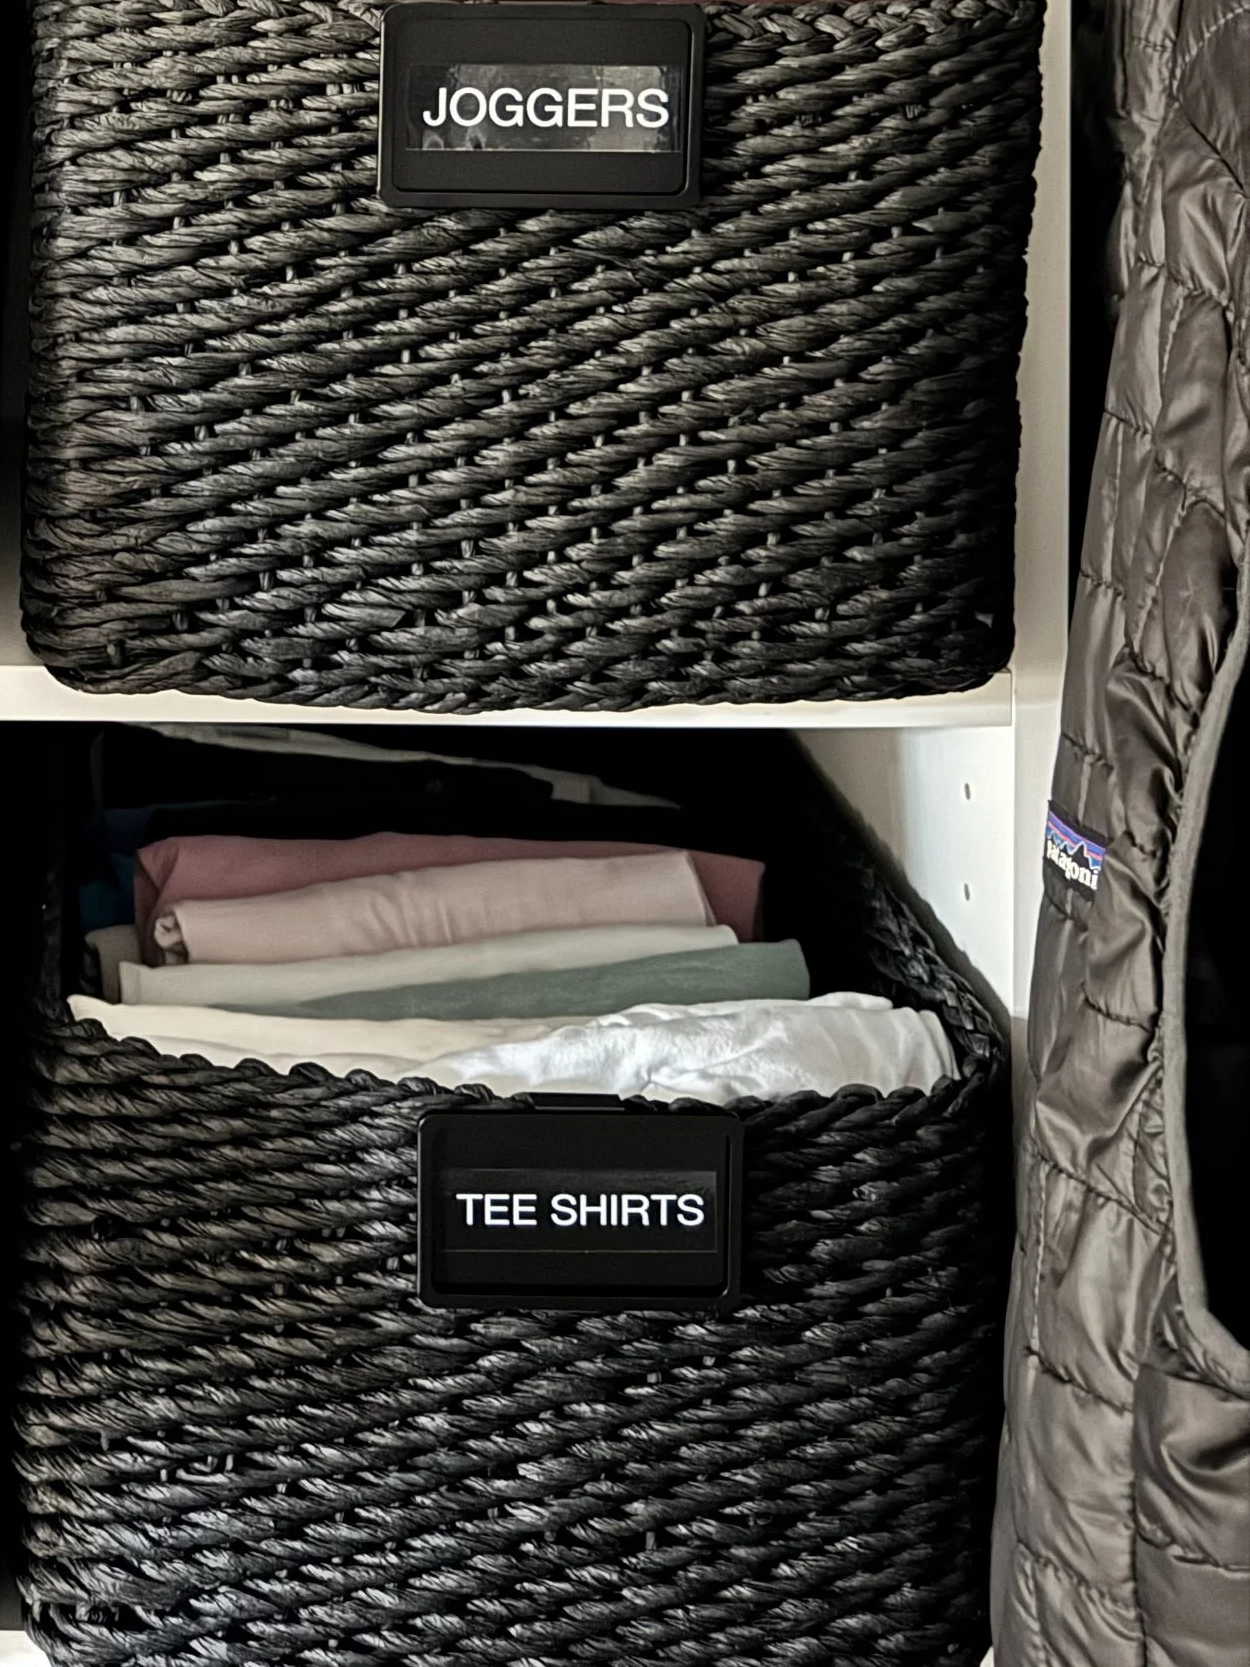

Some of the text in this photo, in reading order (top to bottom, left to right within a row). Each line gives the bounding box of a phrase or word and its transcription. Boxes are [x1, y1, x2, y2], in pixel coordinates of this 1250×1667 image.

[422, 86, 669, 128] JOGGERS
[456, 1192, 705, 1226] TEE SHIRTS
